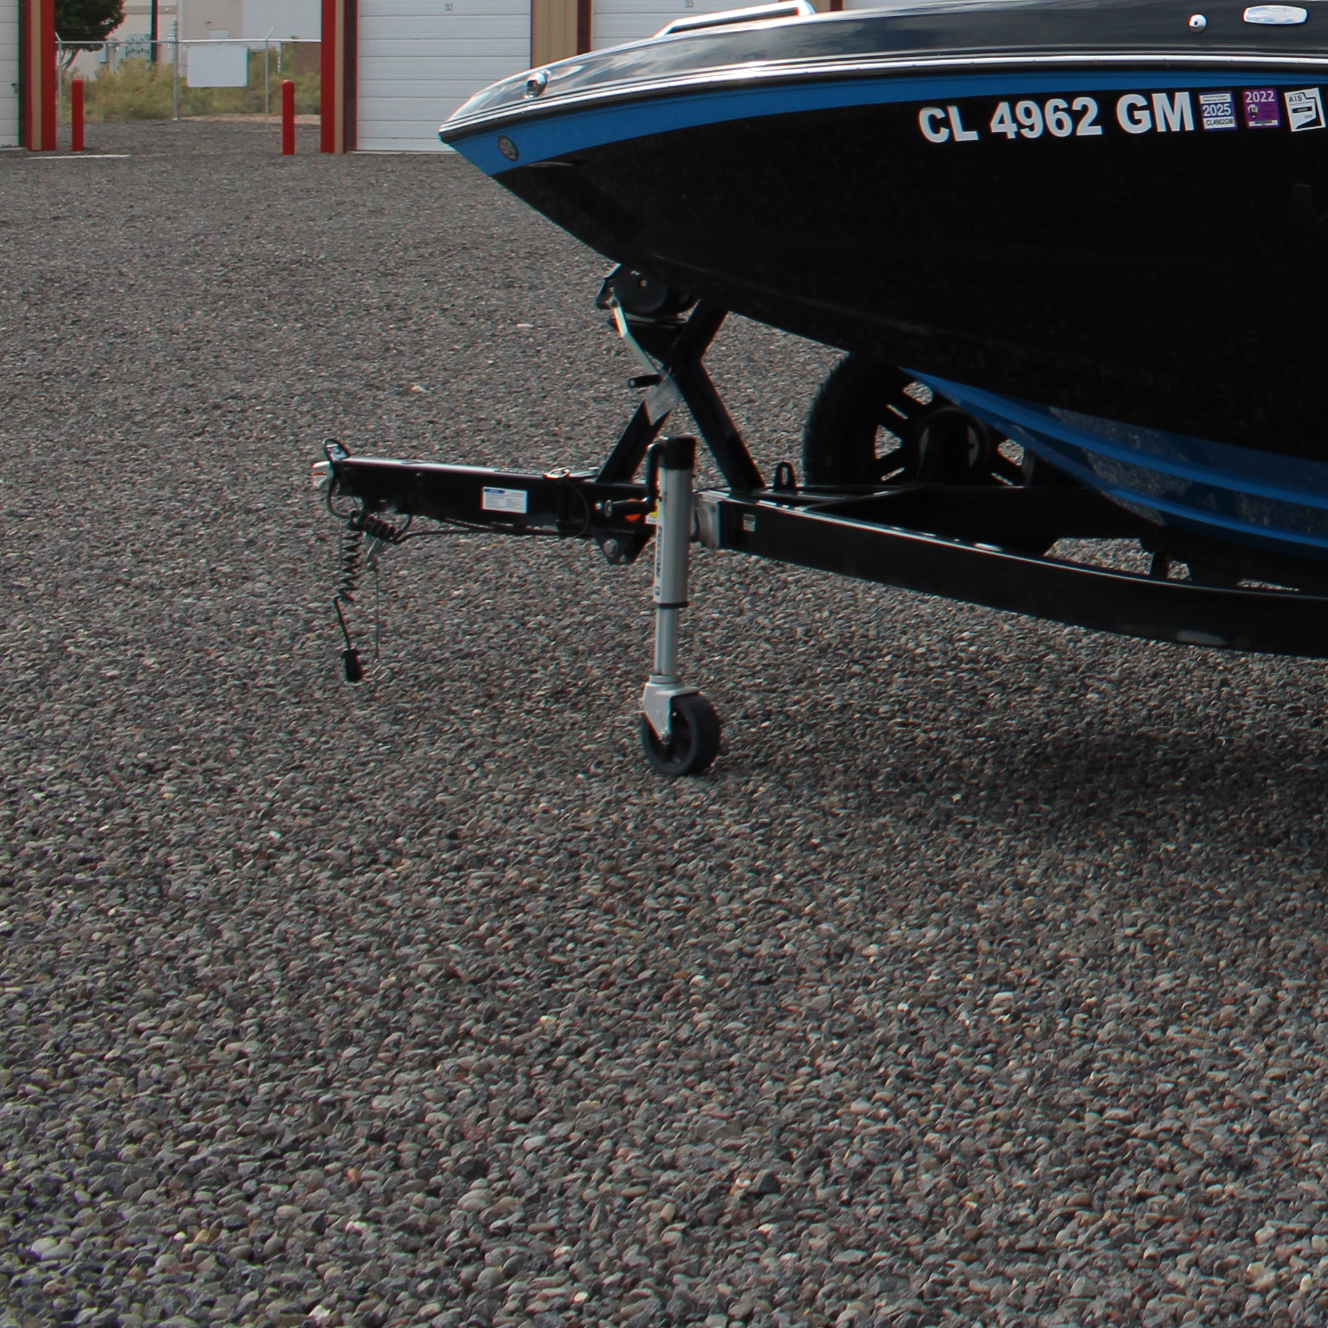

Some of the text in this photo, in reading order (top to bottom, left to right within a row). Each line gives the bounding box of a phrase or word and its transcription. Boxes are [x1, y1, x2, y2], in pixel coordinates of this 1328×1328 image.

[1245, 90, 1275, 103] 2022
[1288, 95, 1303, 103] AIS
[918, 91, 1195, 143] CL 4962 GM
[1202, 104, 1231, 117] 2025
